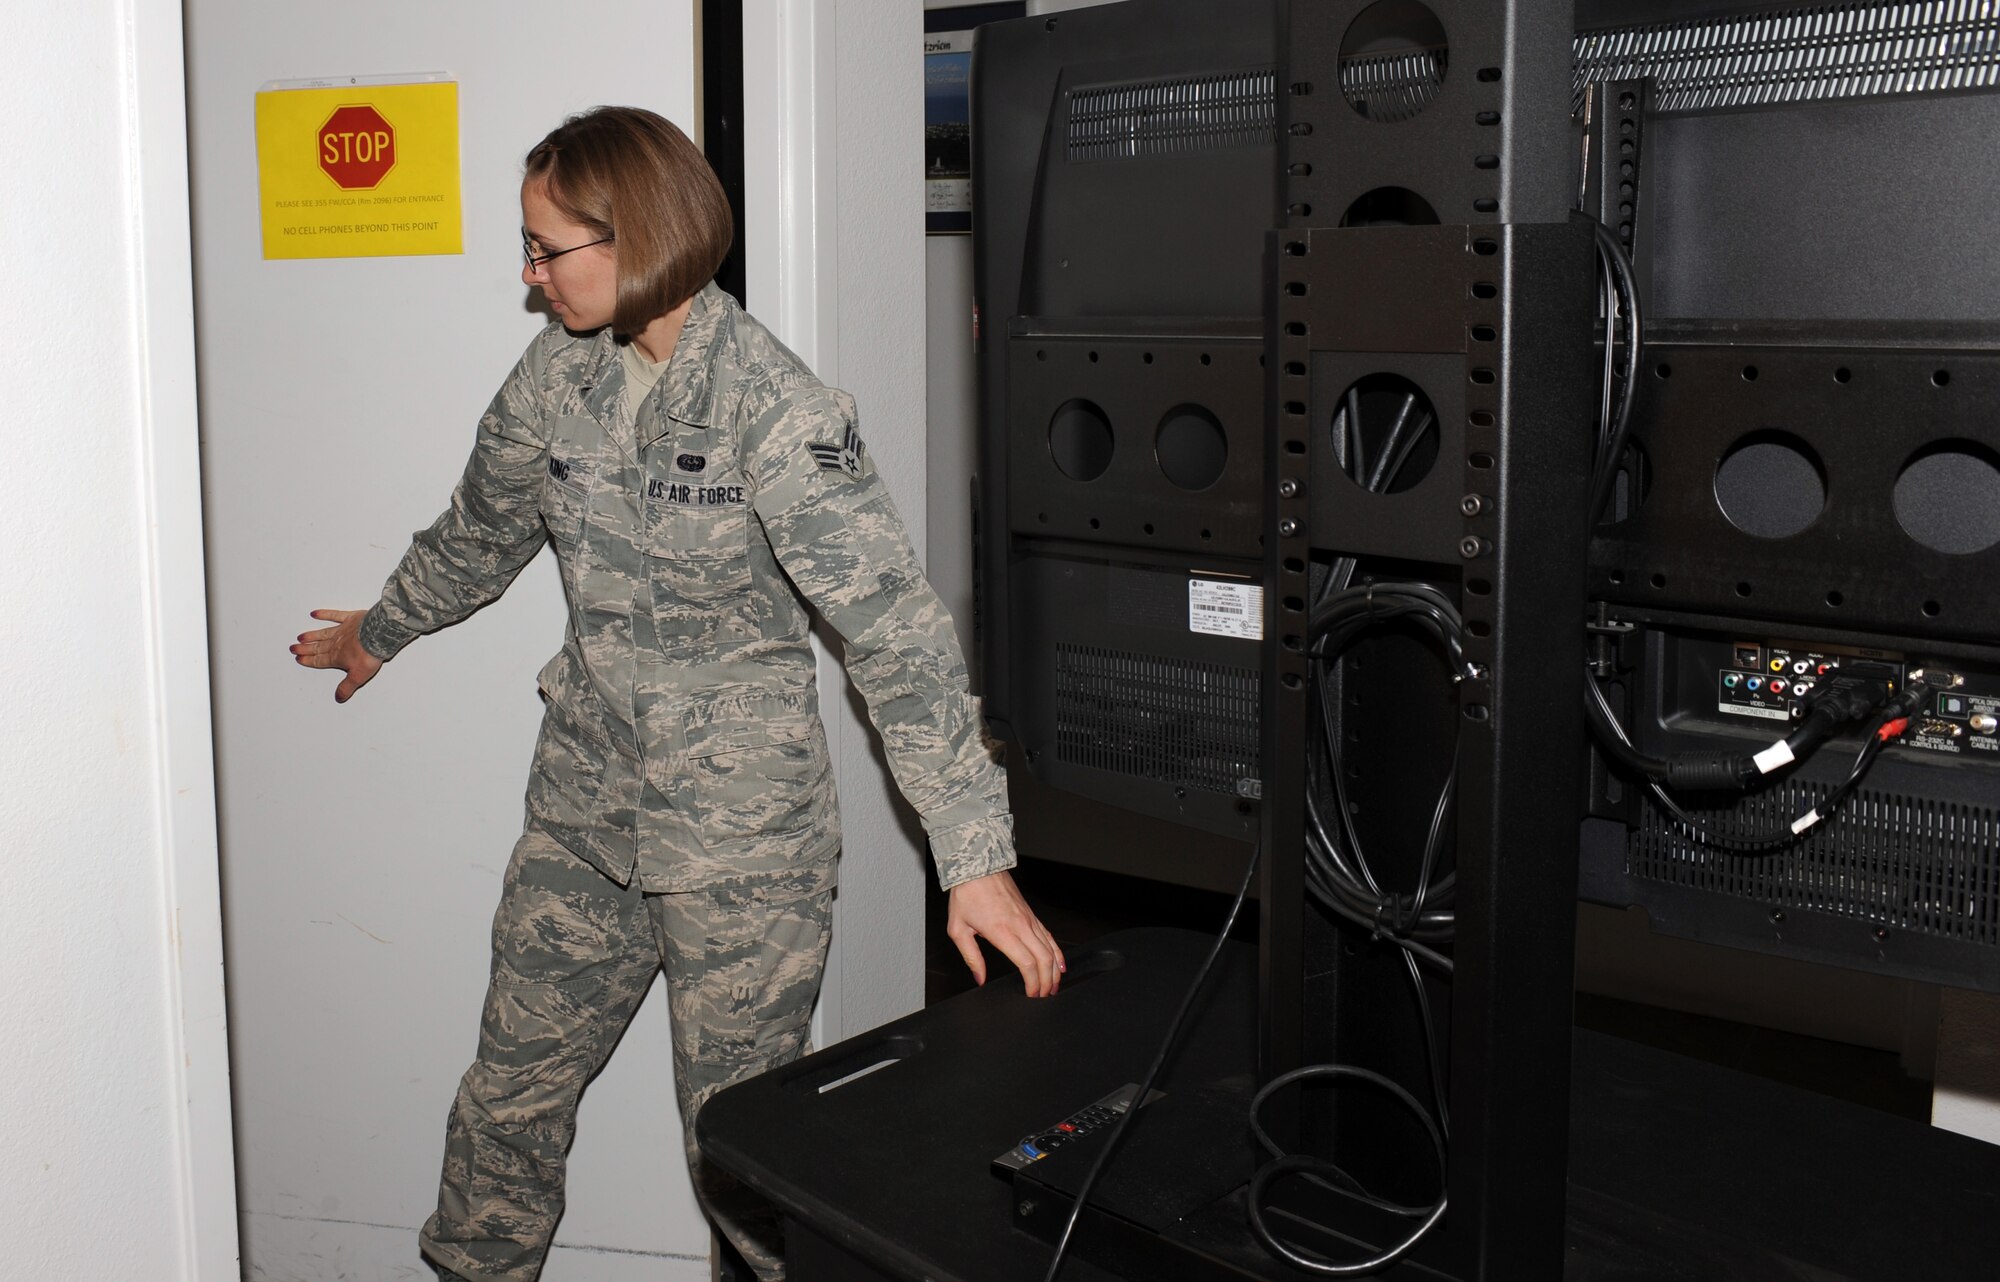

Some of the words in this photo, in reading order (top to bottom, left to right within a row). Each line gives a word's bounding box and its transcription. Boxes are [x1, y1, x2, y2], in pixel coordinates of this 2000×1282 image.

[323, 131, 390, 164] STOP
[276, 200, 300, 208] PLEASE
[302, 199, 315, 207] SEE
[315, 198, 328, 207] 355
[393, 196, 407, 204] FOR
[408, 194, 445, 203] ENTRANCE
[283, 227, 297, 236] NO
[298, 226, 317, 235] CELL
[319, 225, 353, 235] PHONES
[355, 223, 389, 233] BEYOND
[391, 222, 410, 231] THIS
[412, 221, 439, 231] POINT
[648, 479, 665, 500] U.S.
[668, 484, 691, 504] AIR
[698, 486, 745, 504] FORCE
[1749, 700, 1766, 708] VIDEO
[1729, 704, 1766, 716] COMPONENT
[1768, 710, 1776, 718] IN
[1915, 735, 1945, 744] RS-232C
[1946, 738, 1954, 746] IN
[1969, 735, 1997, 744] ANTENNA
[1970, 742, 1991, 750] CABLE
[1909, 740, 1932, 749] (CONTROL
[1938, 744, 1960, 753] SERVICE)
